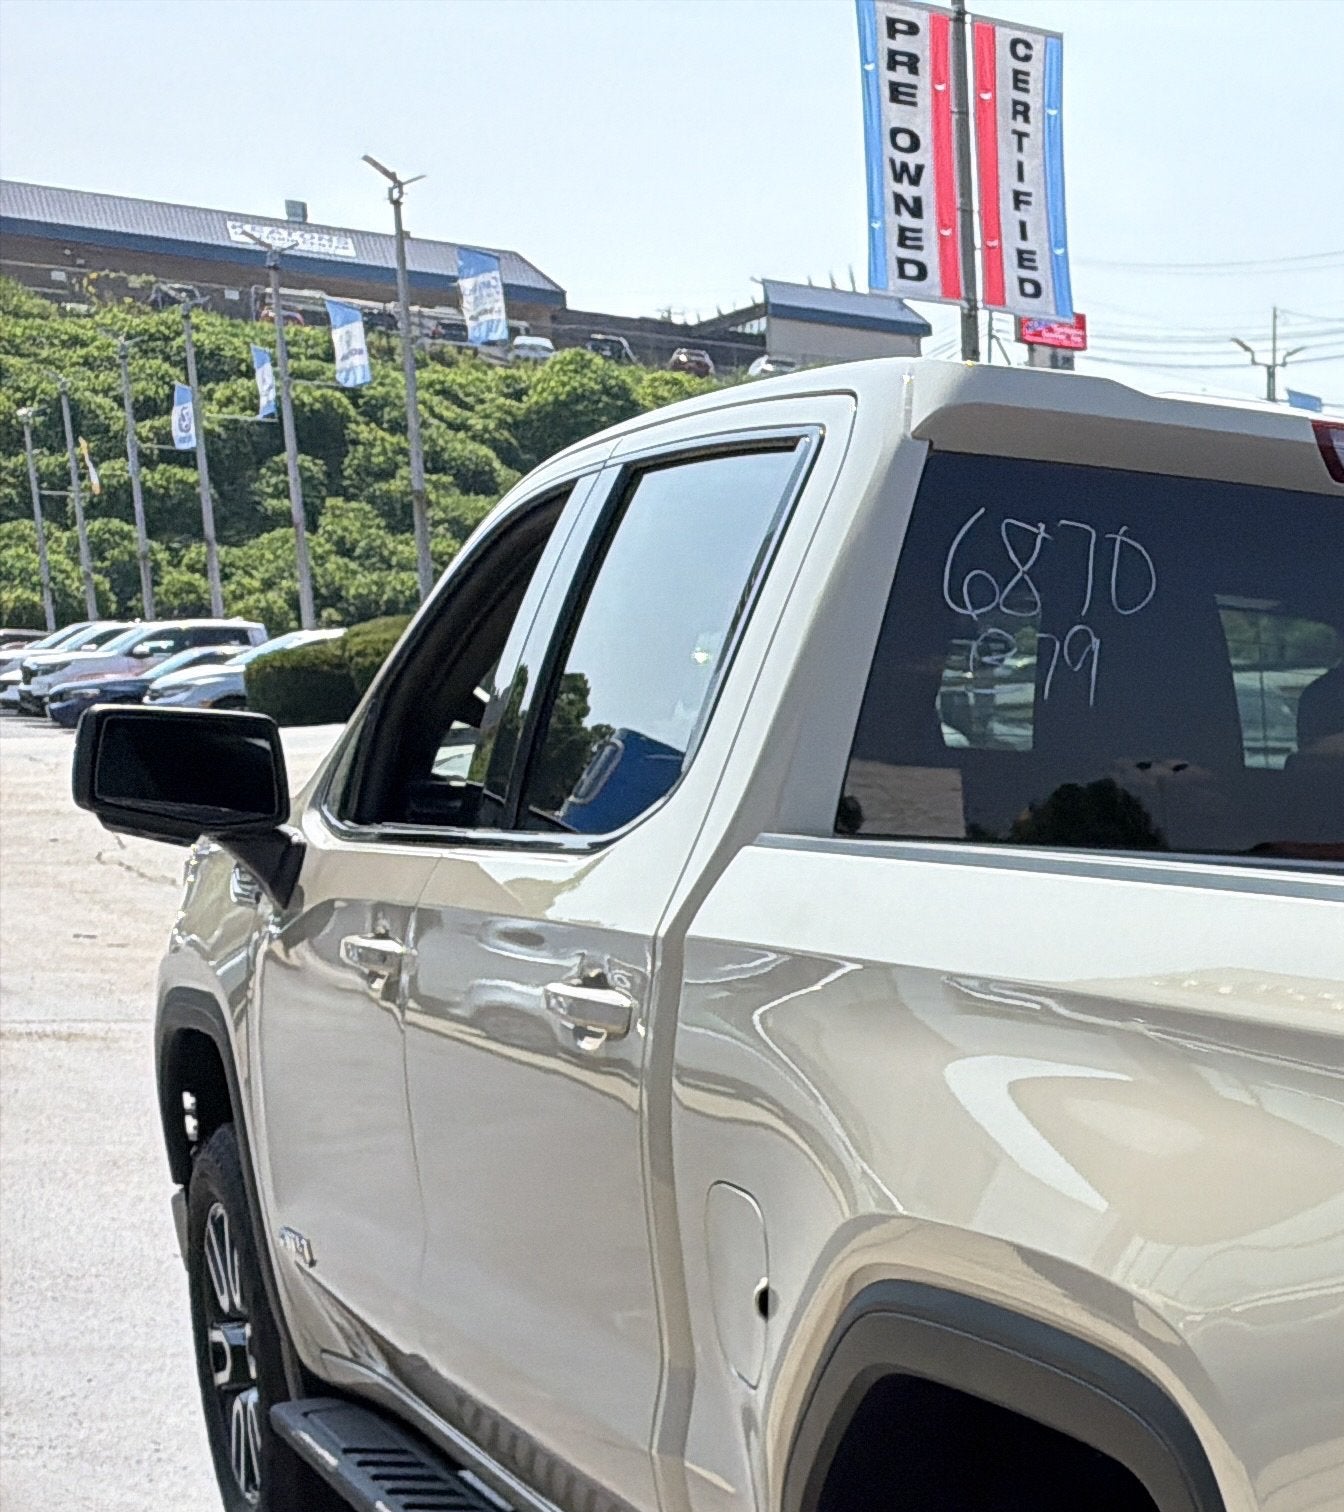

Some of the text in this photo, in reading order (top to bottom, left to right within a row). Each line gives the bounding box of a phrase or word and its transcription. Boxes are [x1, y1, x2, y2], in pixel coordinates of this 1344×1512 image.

[886, 16, 928, 282] PRE OWNED
[1009, 38, 1042, 299] CERTIFIED
[943, 507, 1156, 621] 6870
